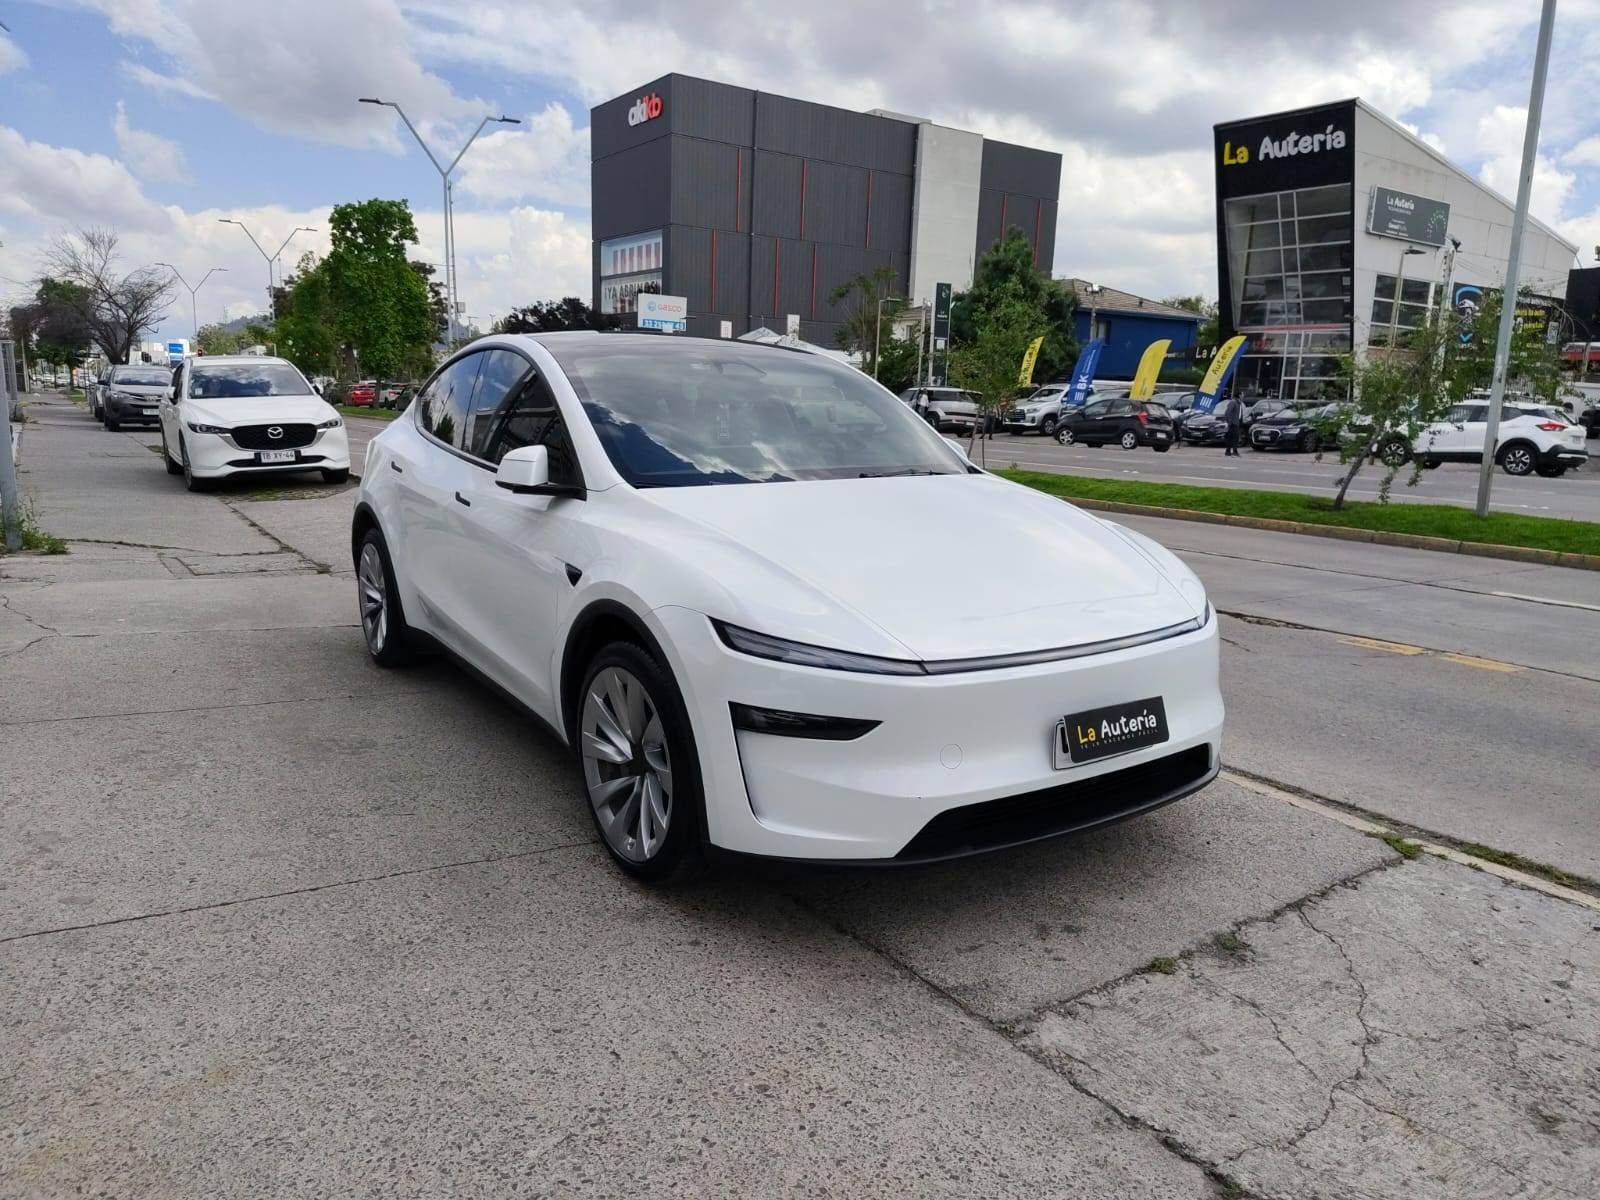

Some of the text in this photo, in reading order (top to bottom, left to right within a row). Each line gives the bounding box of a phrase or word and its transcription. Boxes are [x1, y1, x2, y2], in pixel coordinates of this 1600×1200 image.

[1223, 124, 1346, 166] La Autería
[1386, 195, 1394, 205] La
[1195, 346, 1208, 359] La
[1077, 374, 1089, 389] BK
[1077, 709, 1157, 744] La Autería
